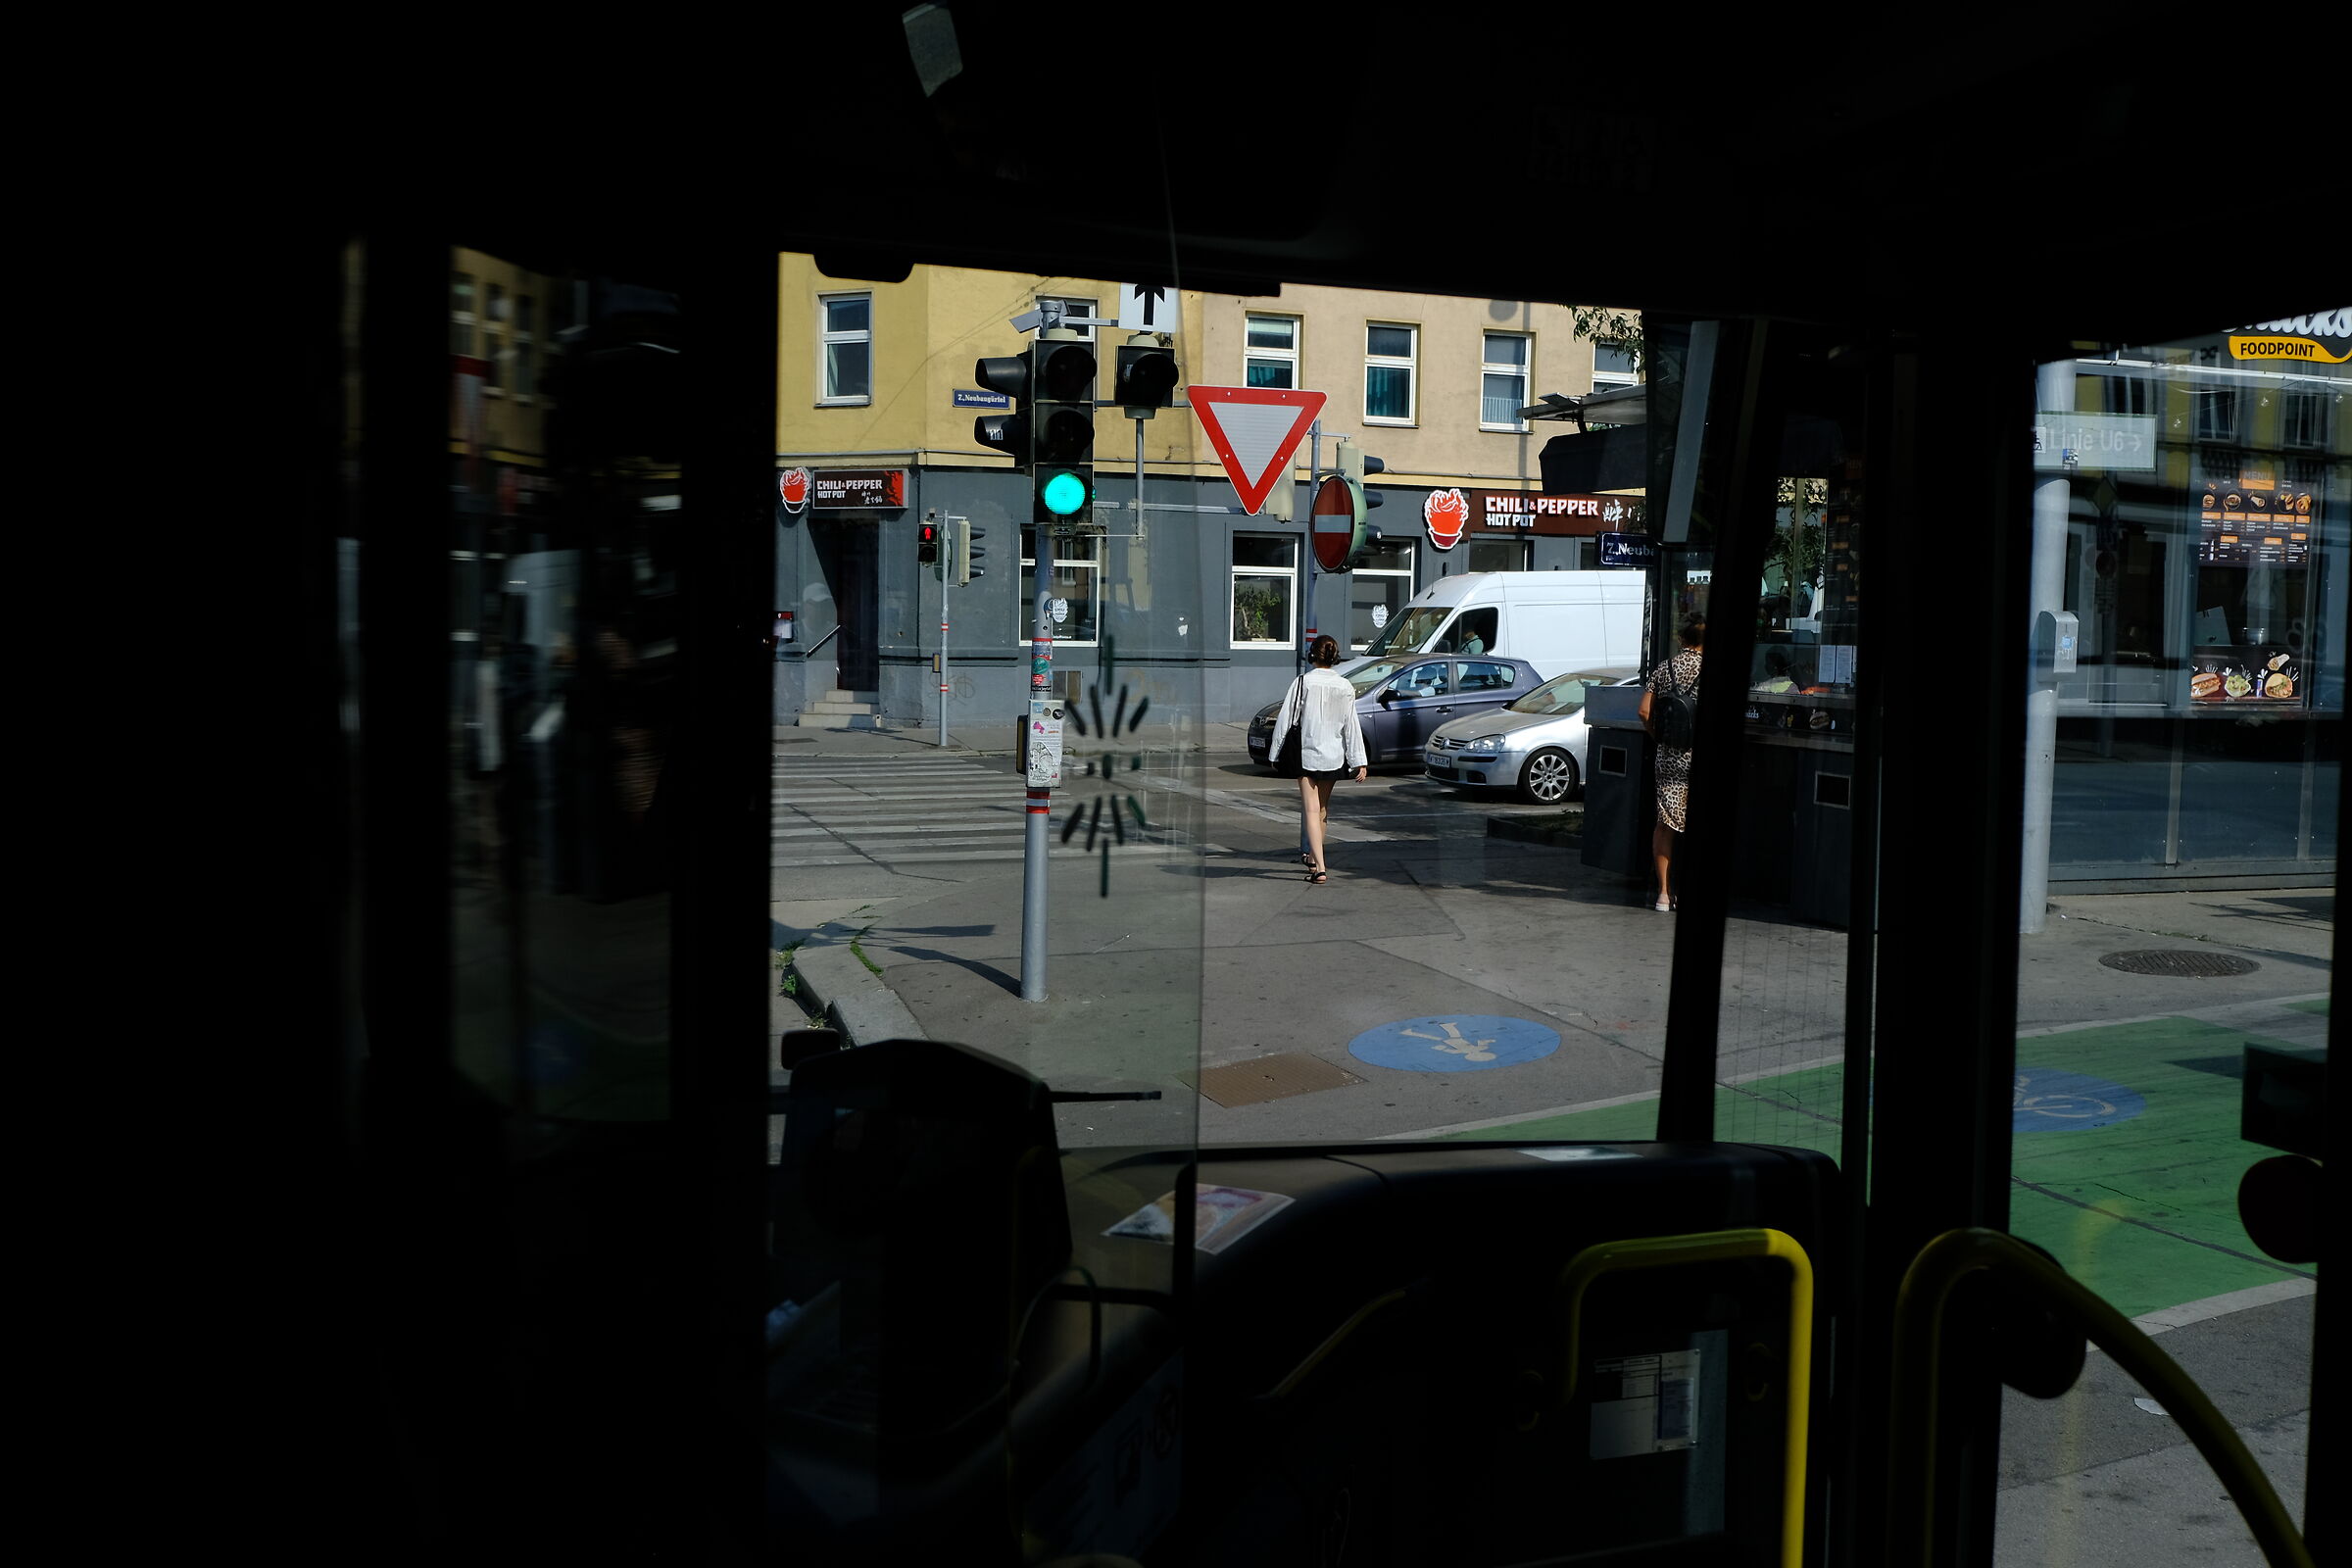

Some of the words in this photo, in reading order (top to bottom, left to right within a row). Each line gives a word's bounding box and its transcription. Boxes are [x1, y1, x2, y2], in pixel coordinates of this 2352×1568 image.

[2240, 342, 2316, 357] FOODPOINT
[2049, 427, 2094, 451] Linie
[2100, 429, 2124, 452] U6
[2243, 470, 2271, 480] MENU
[817, 490, 832, 499] HOT
[832, 490, 846, 499] POT
[1486, 513, 1511, 526] HOT
[1511, 514, 1537, 527] POT
